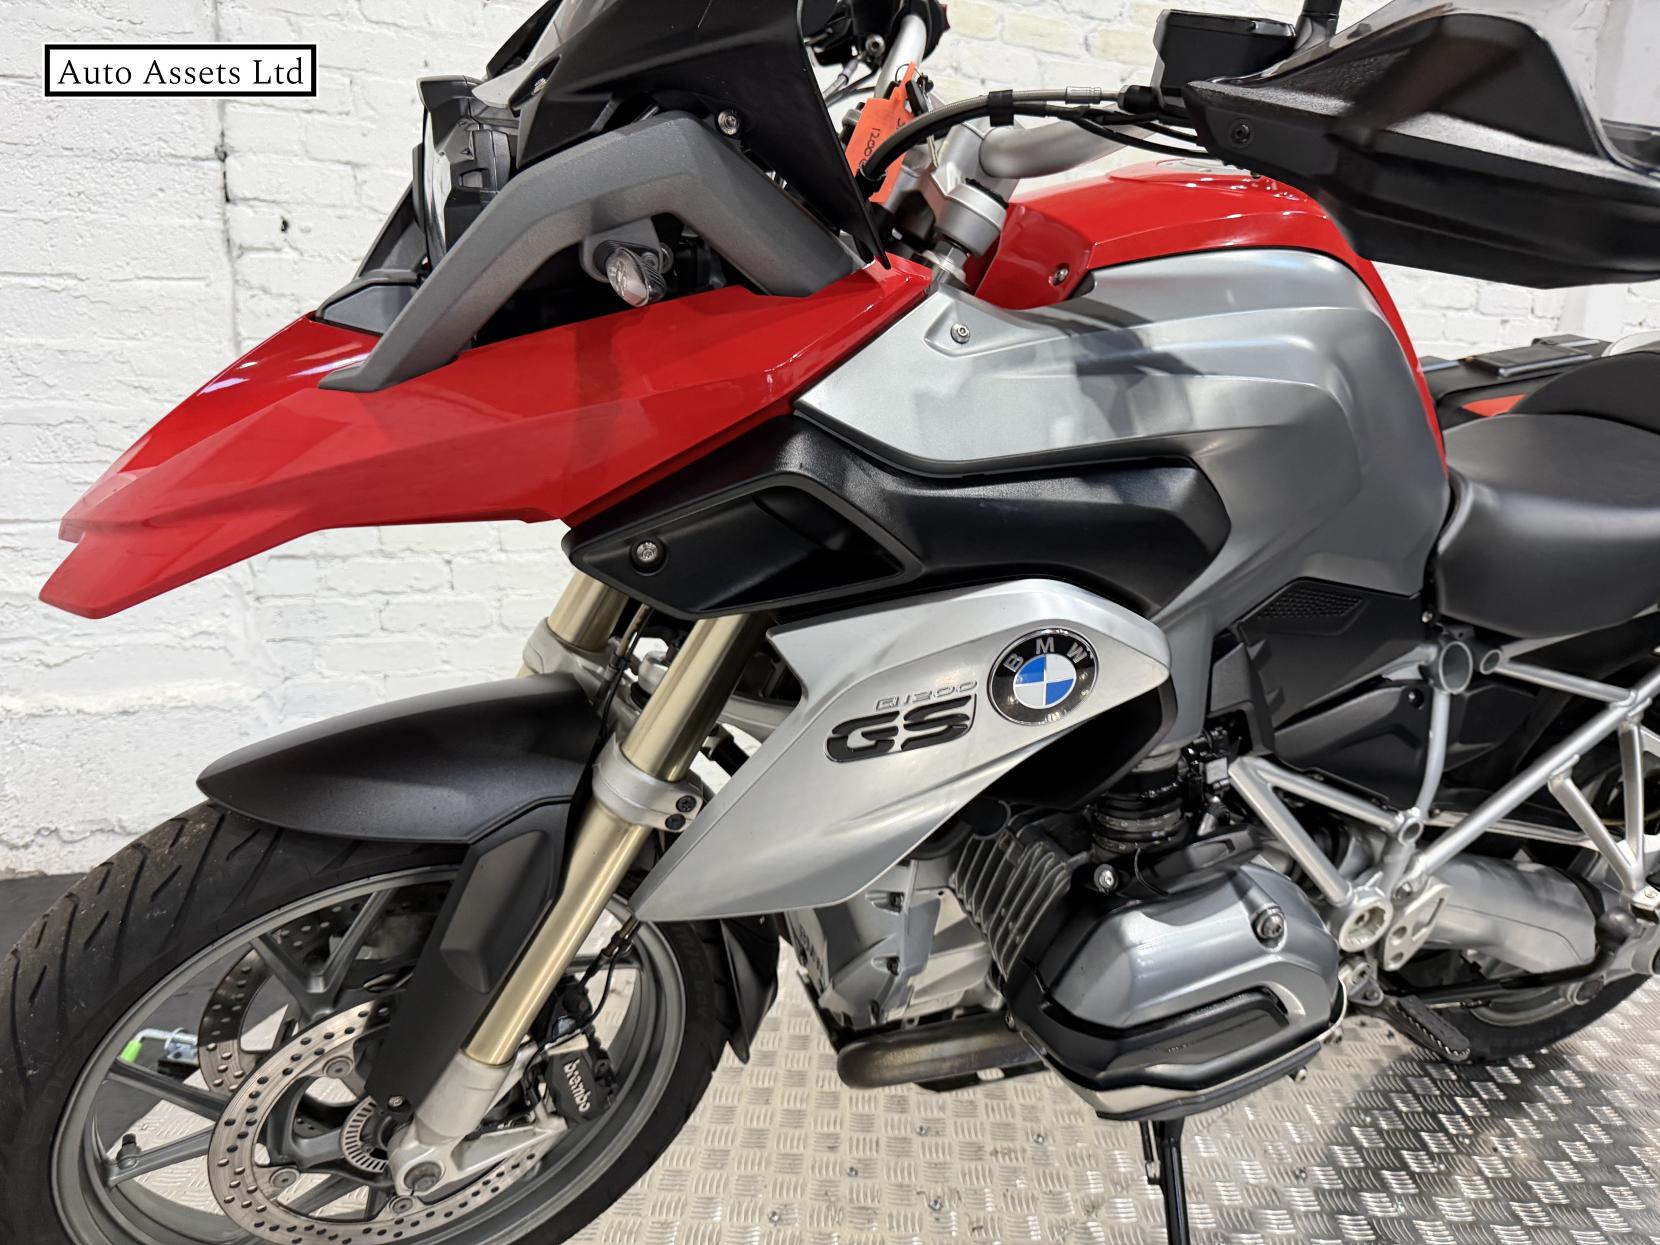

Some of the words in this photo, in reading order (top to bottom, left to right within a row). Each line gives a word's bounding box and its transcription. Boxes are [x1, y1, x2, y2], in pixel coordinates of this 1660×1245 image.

[1003, 636, 1087, 672] BMW
[875, 680, 978, 711] R1200
[825, 693, 977, 763] GS
[563, 1058, 592, 1112] brembo
